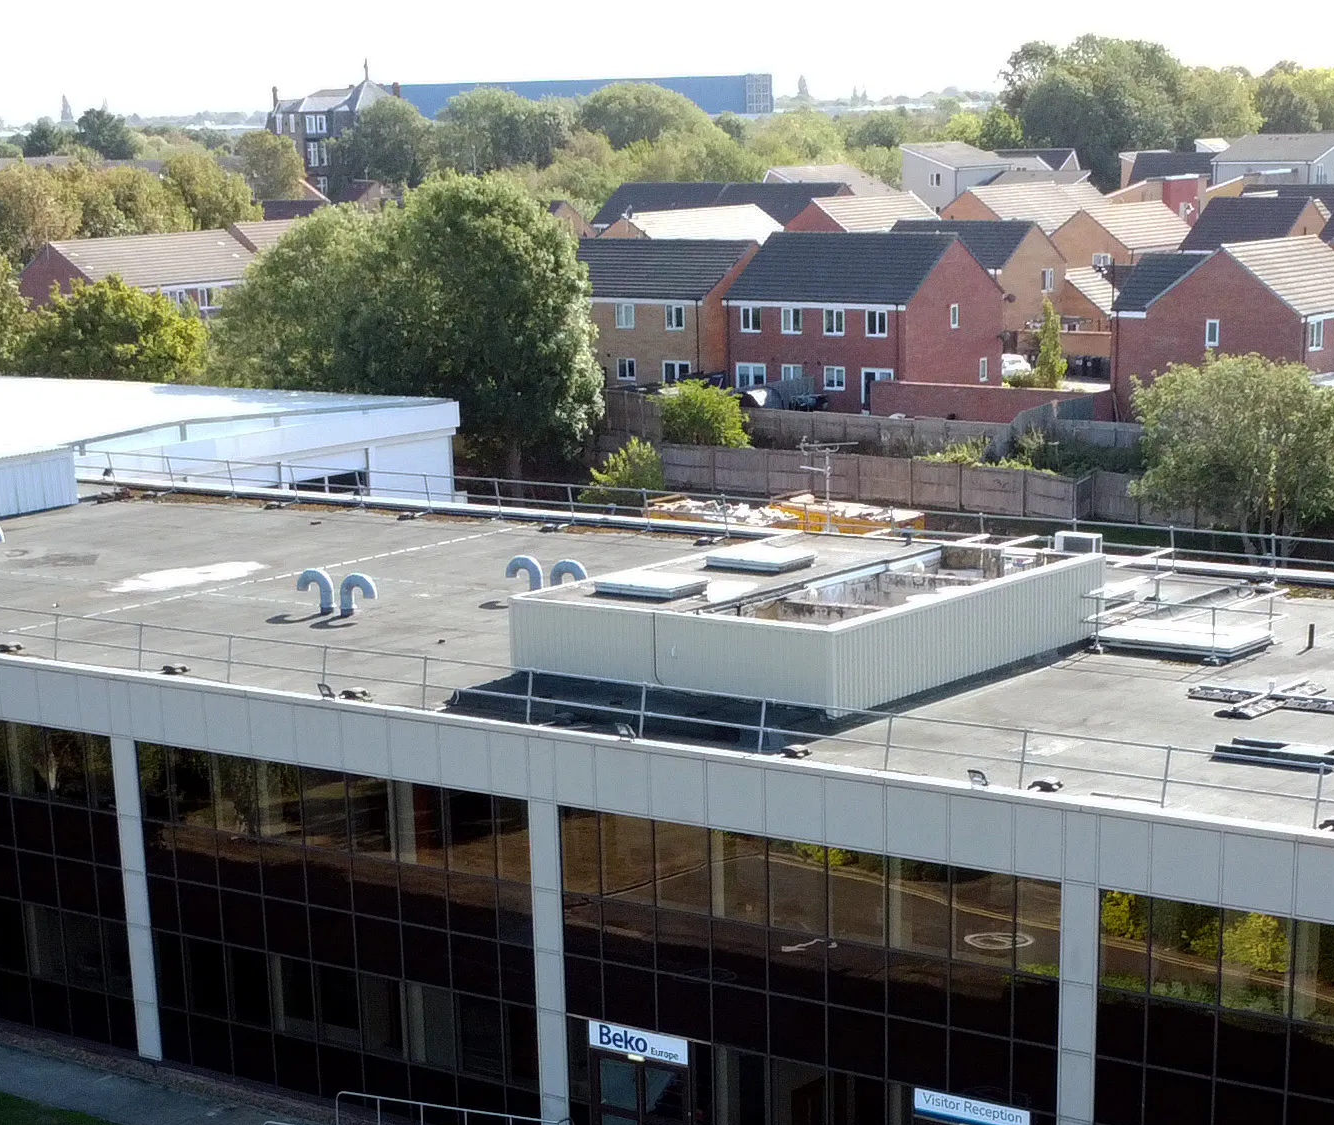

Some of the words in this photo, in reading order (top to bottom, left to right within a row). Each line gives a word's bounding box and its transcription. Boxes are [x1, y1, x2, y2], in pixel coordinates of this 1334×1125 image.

[599, 1024, 648, 1053] Beko
[650, 1047, 679, 1061] Europe
[922, 1092, 961, 1111] Visitor
[963, 1101, 1022, 1124] Reception
